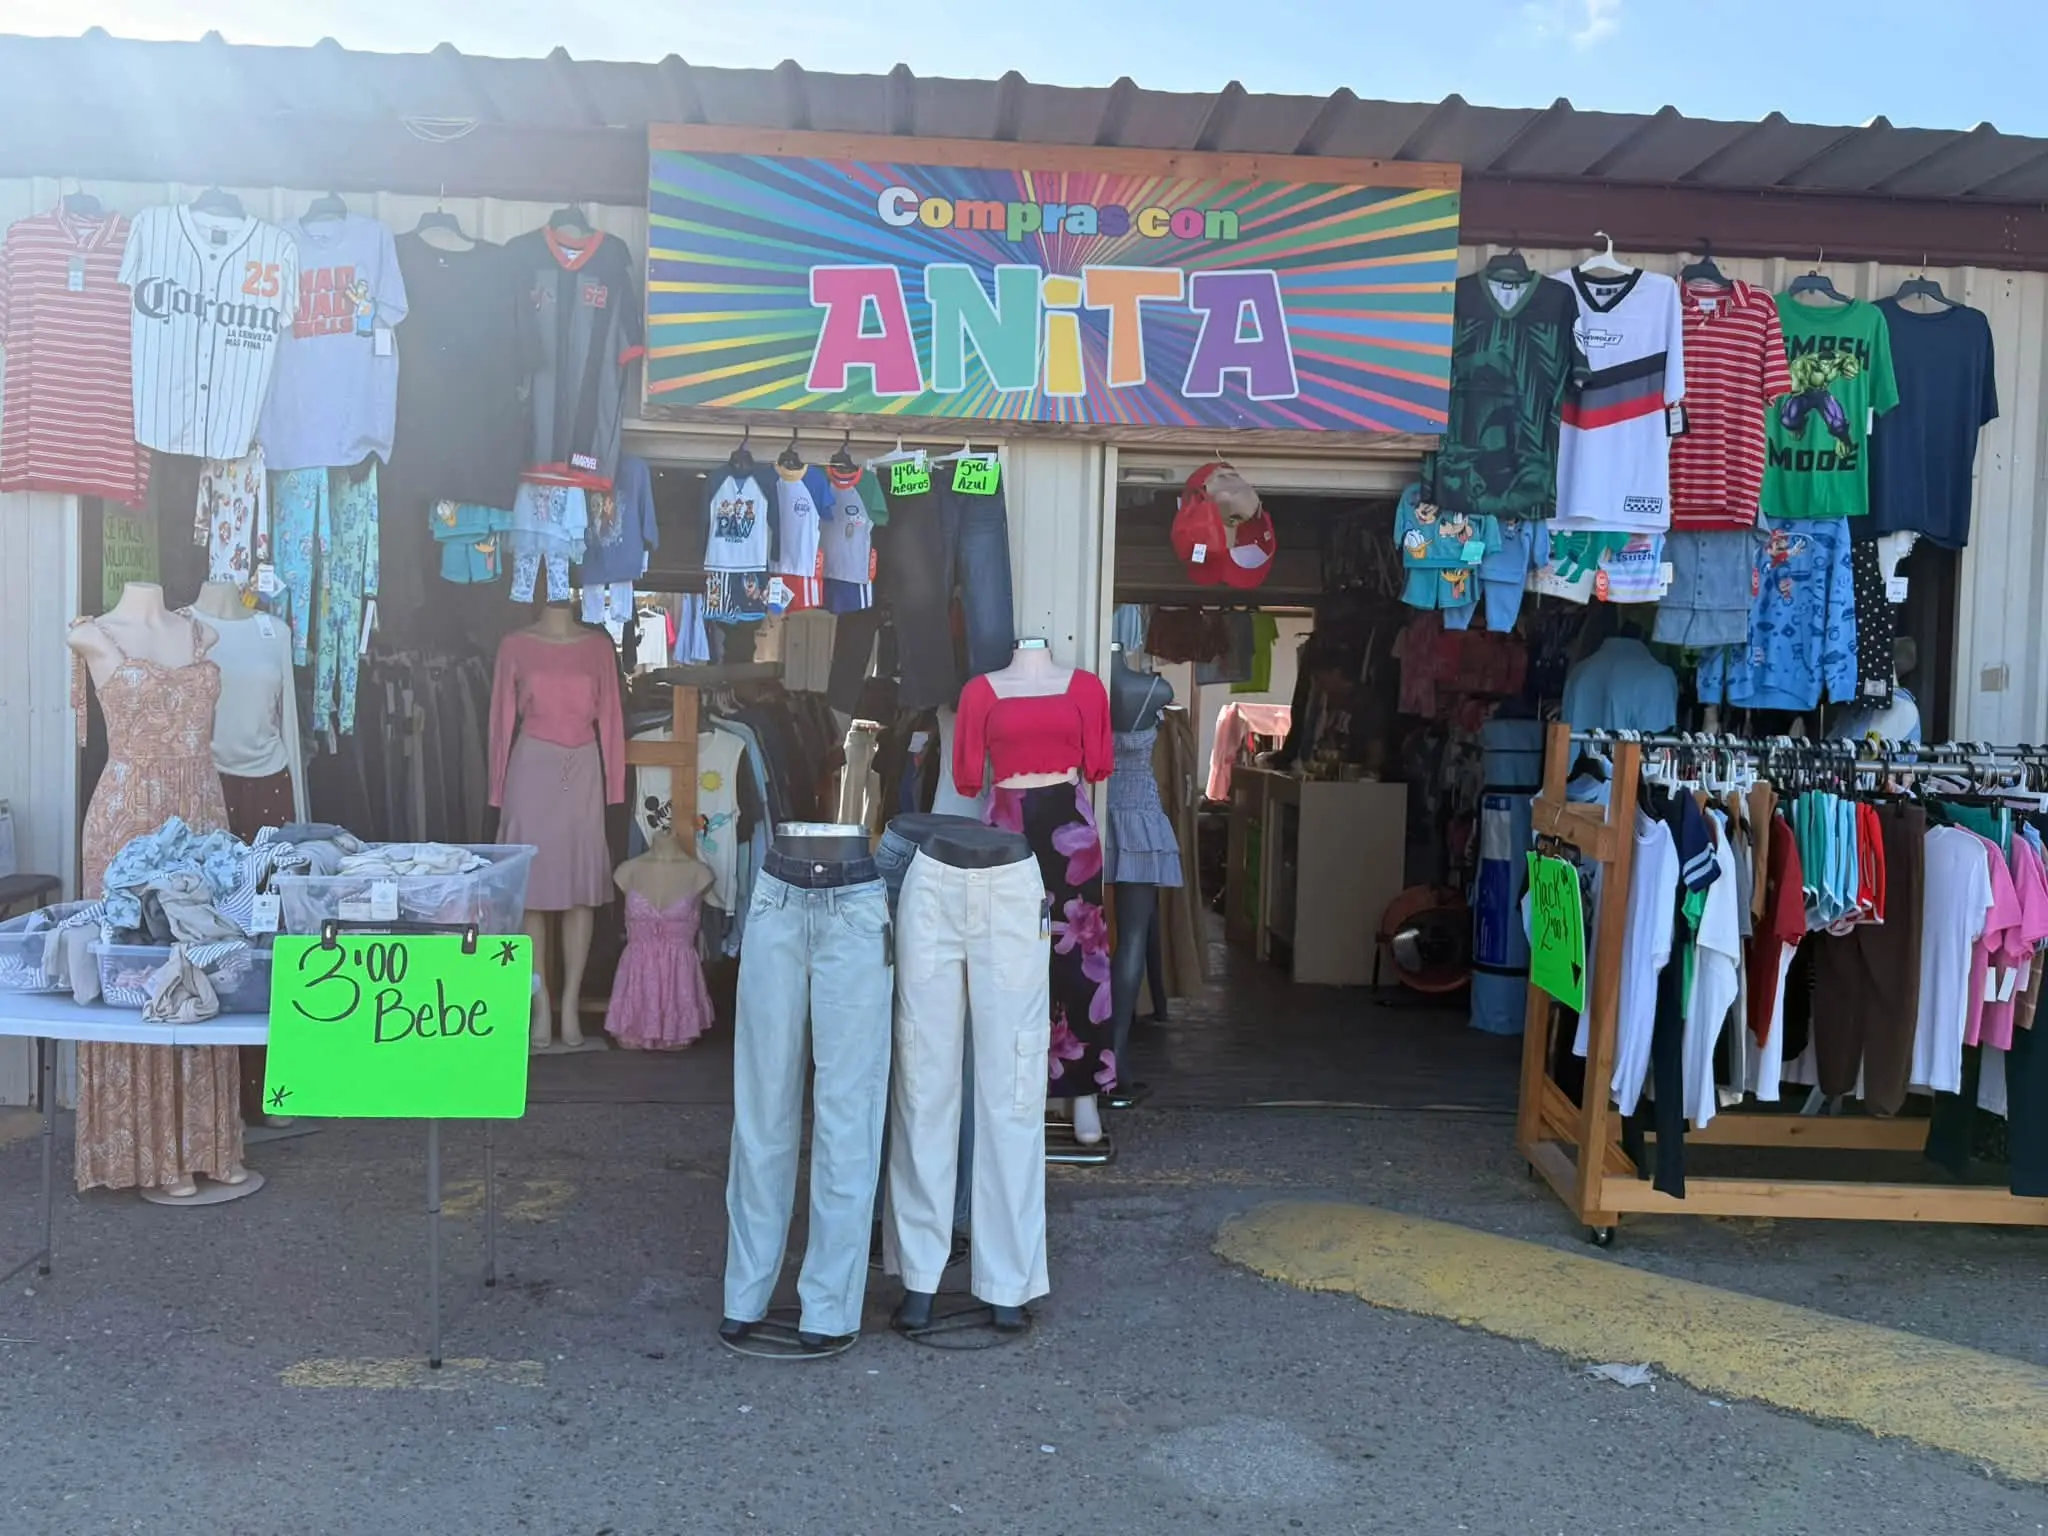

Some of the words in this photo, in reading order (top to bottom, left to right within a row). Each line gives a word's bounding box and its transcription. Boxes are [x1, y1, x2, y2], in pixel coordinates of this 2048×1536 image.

[877, 186, 1130, 242] Compras
[1136, 206, 1239, 241] con
[240, 260, 281, 298] 25
[134, 275, 281, 335] Corona
[1769, 438, 1859, 471] MODE
[957, 476, 987, 490] Azul
[715, 514, 755, 539] PAW
[1532, 858, 1562, 913] Rack
[374, 978, 494, 1043] Bebe
